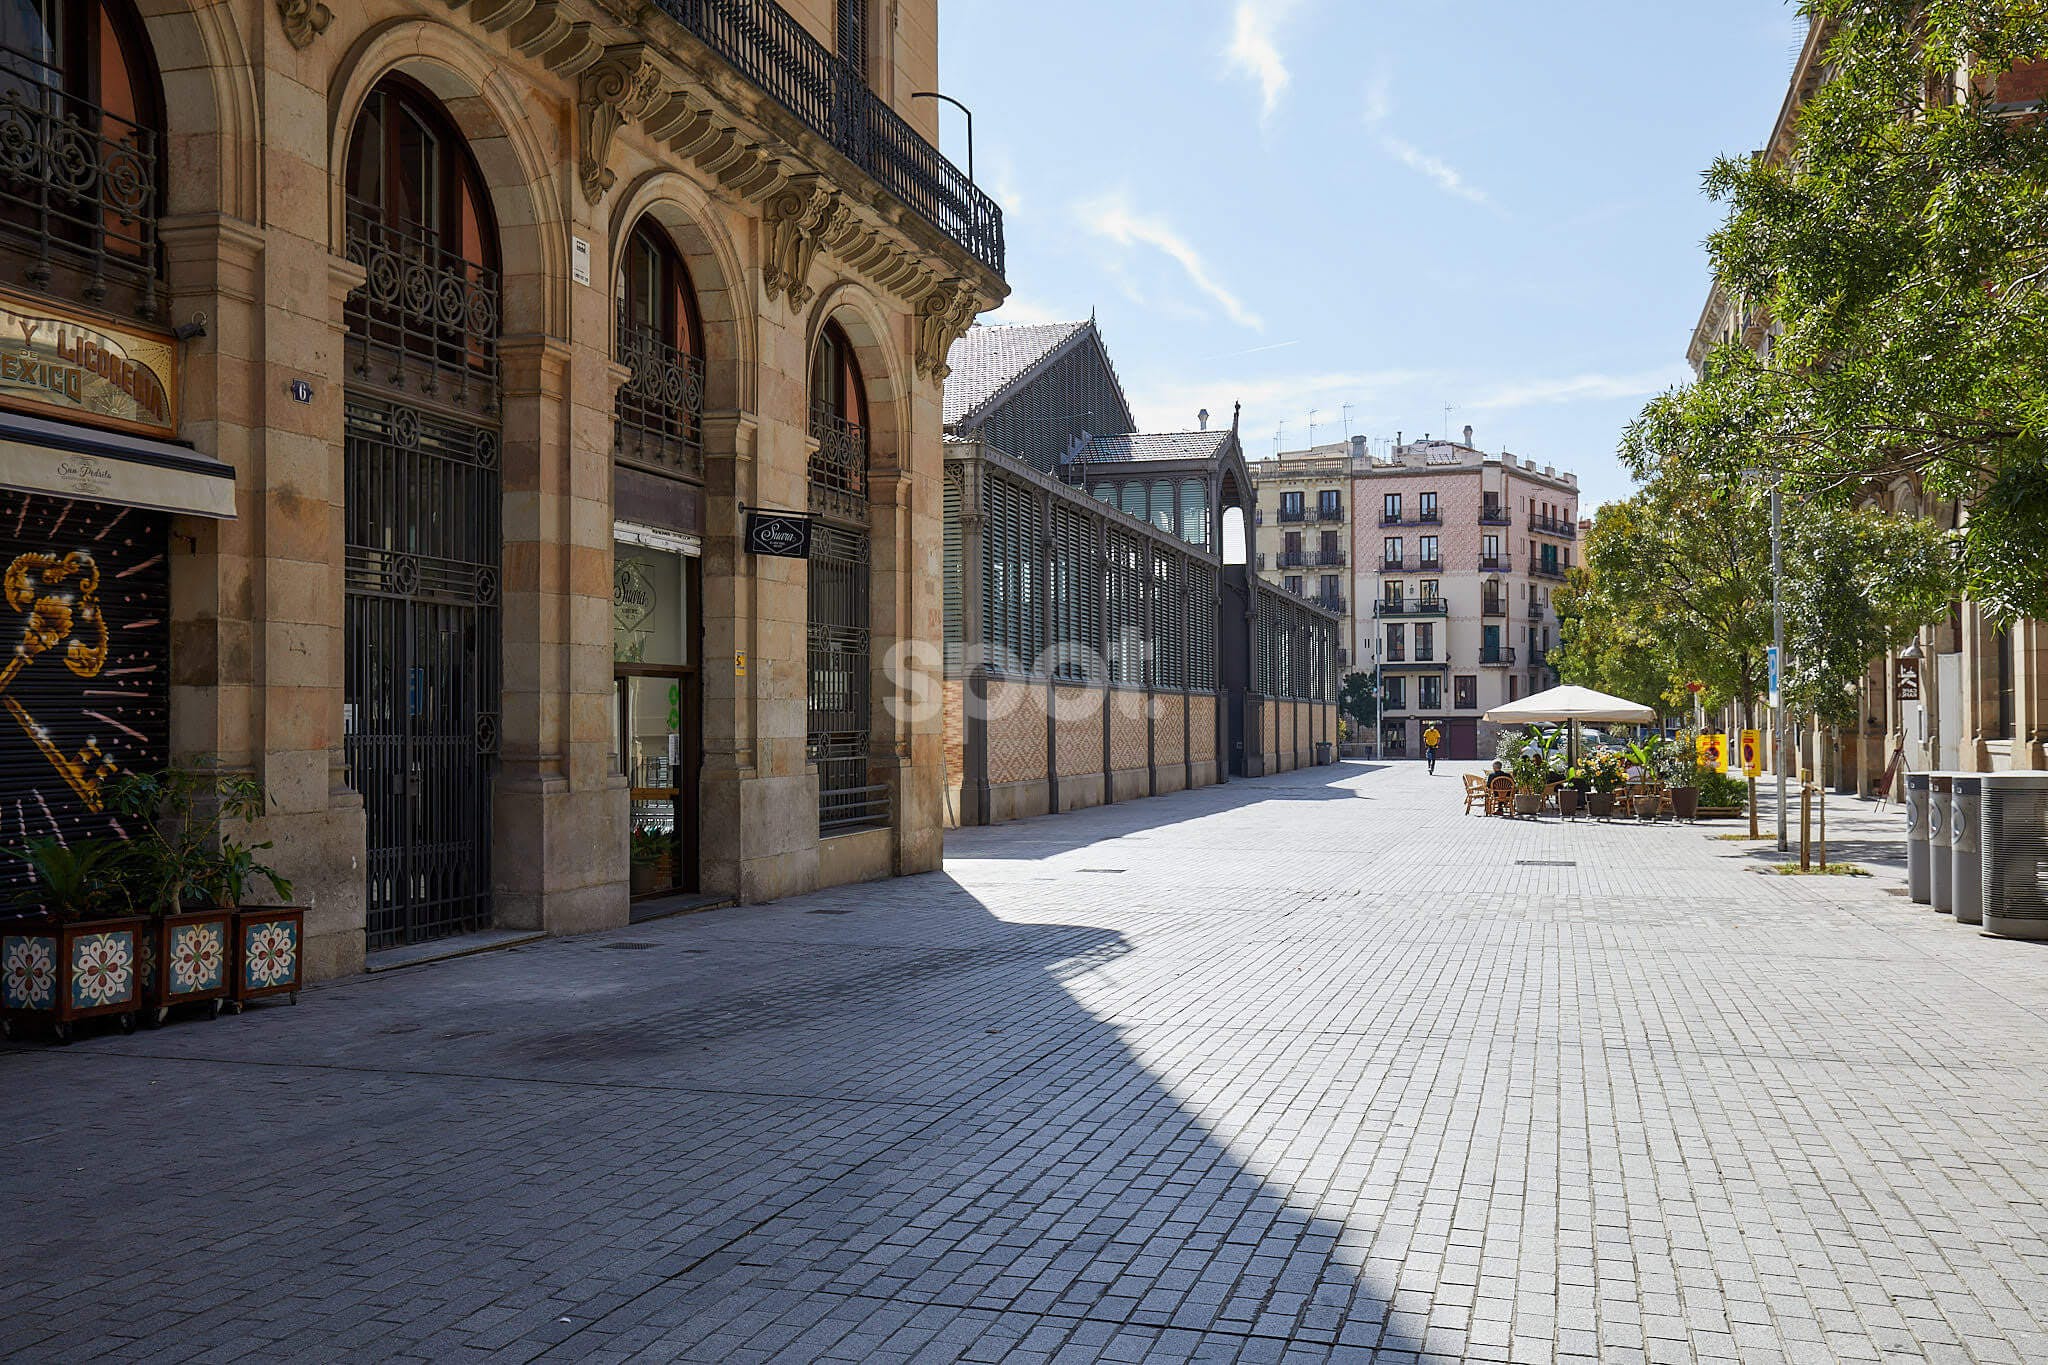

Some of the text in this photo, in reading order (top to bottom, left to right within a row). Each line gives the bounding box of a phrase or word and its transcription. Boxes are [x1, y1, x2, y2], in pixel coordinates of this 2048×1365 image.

[19, 320, 39, 347] Y
[18, 348, 39, 362] DE
[299, 382, 307, 401] 6
[57, 462, 78, 476] San
